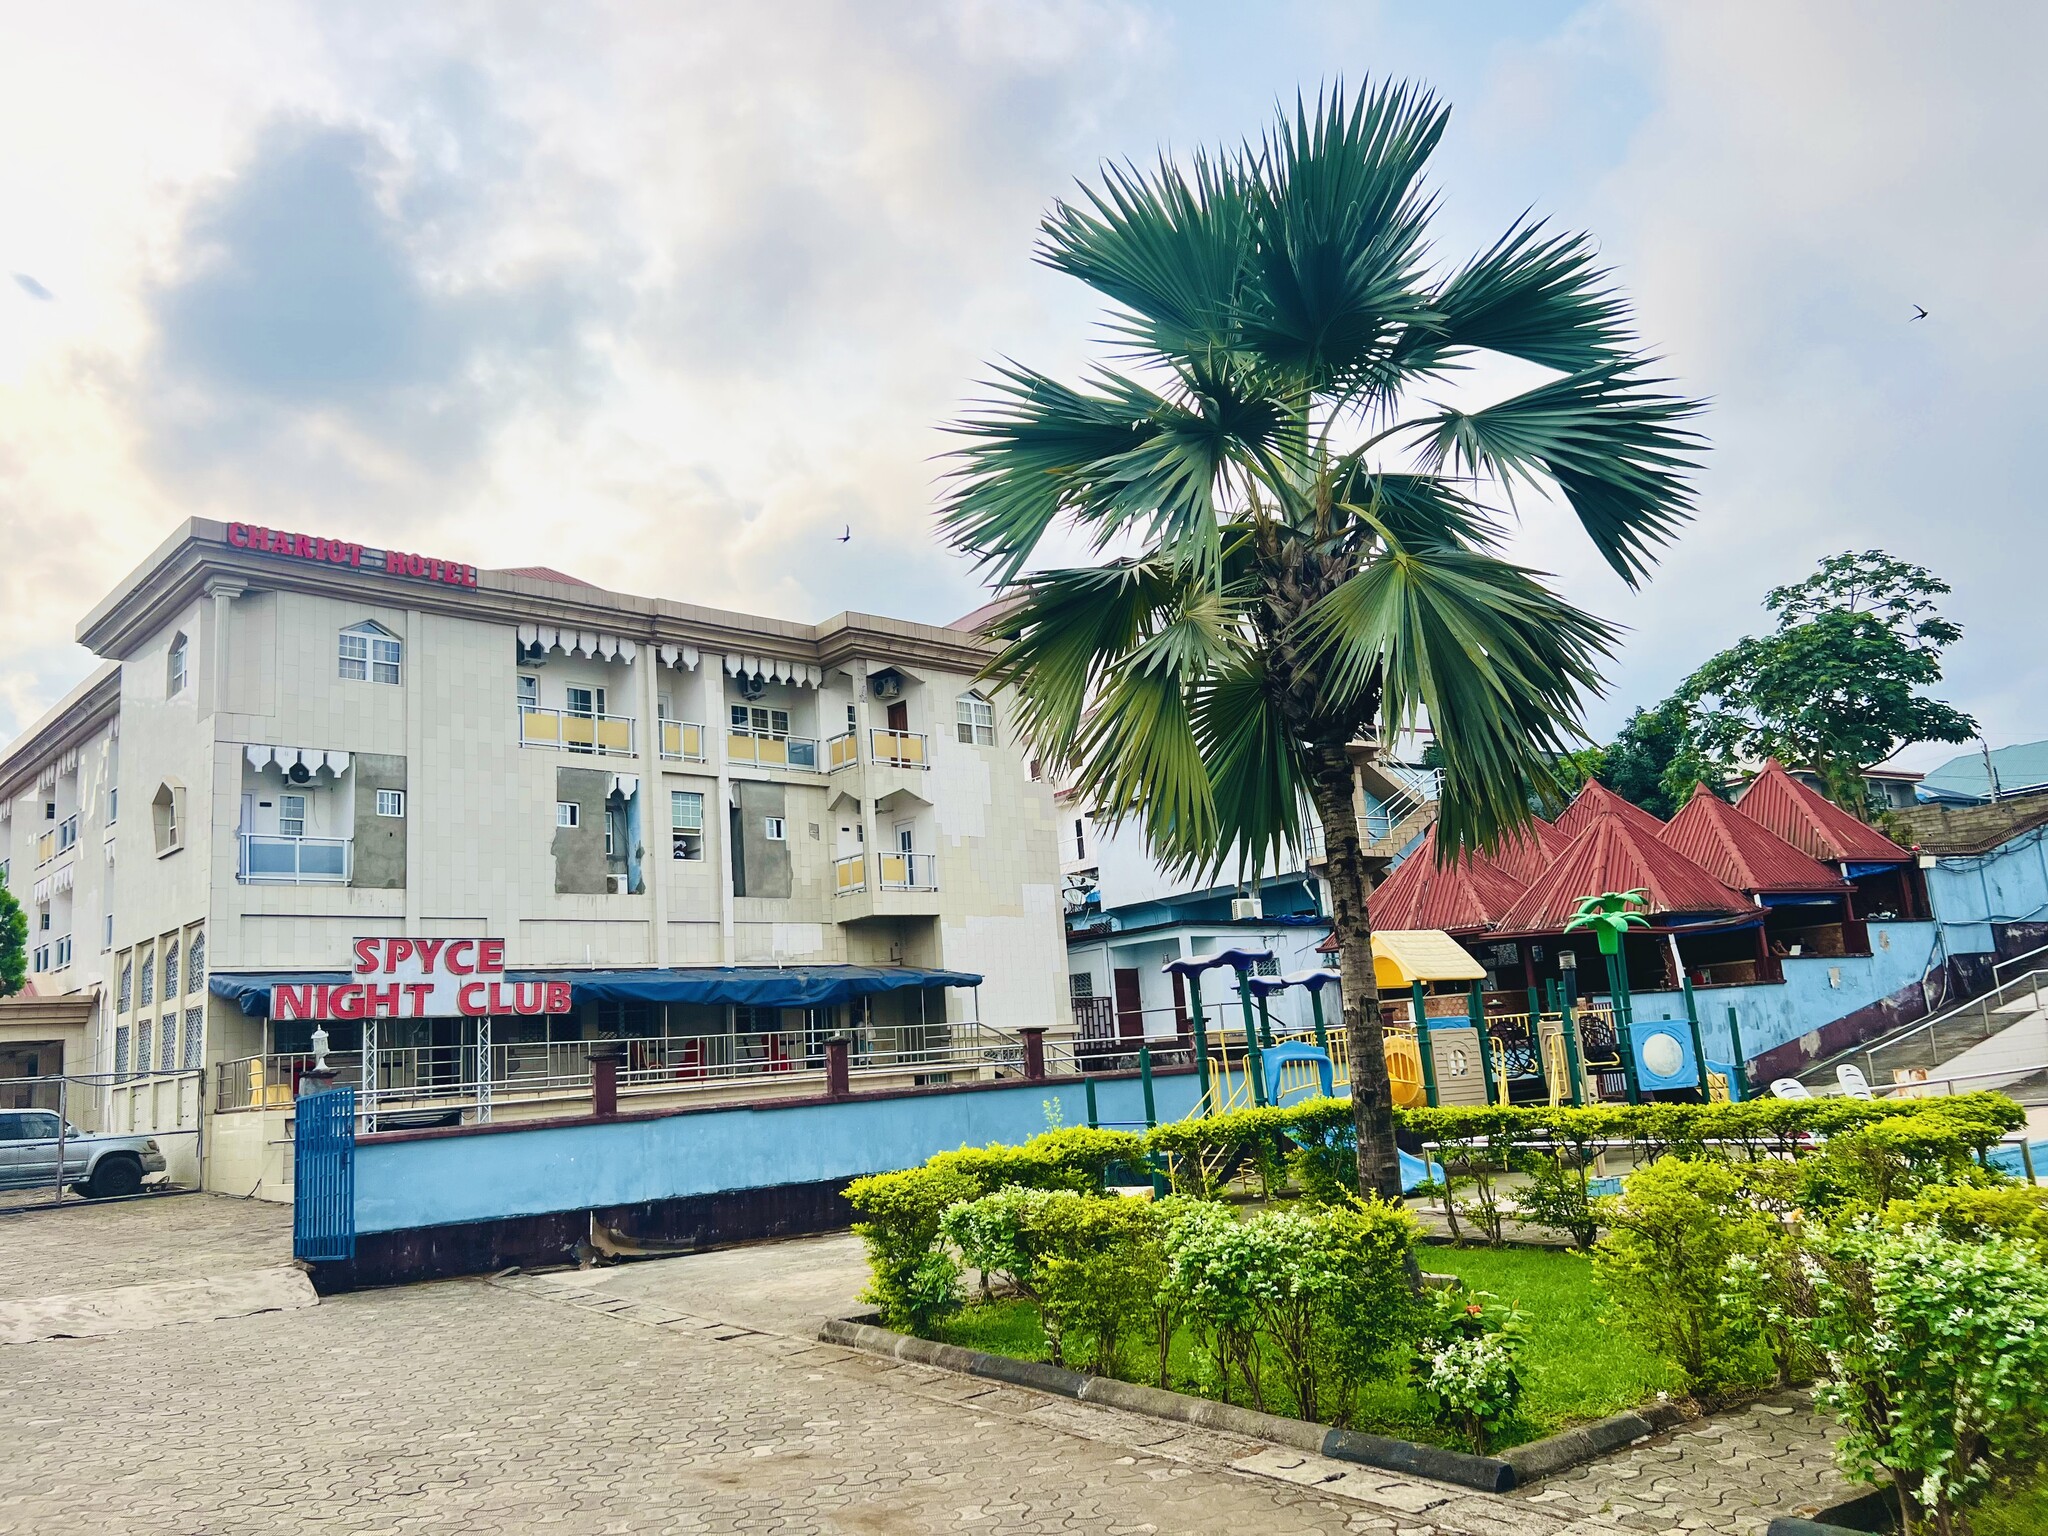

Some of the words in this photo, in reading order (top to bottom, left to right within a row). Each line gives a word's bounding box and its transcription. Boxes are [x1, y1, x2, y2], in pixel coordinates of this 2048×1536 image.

[228, 522, 363, 567] CHARIOT
[386, 550, 476, 587] HOTEL
[355, 938, 504, 974] SPYCE
[273, 983, 434, 1020] NIGHT
[457, 981, 572, 1016] CLUB
